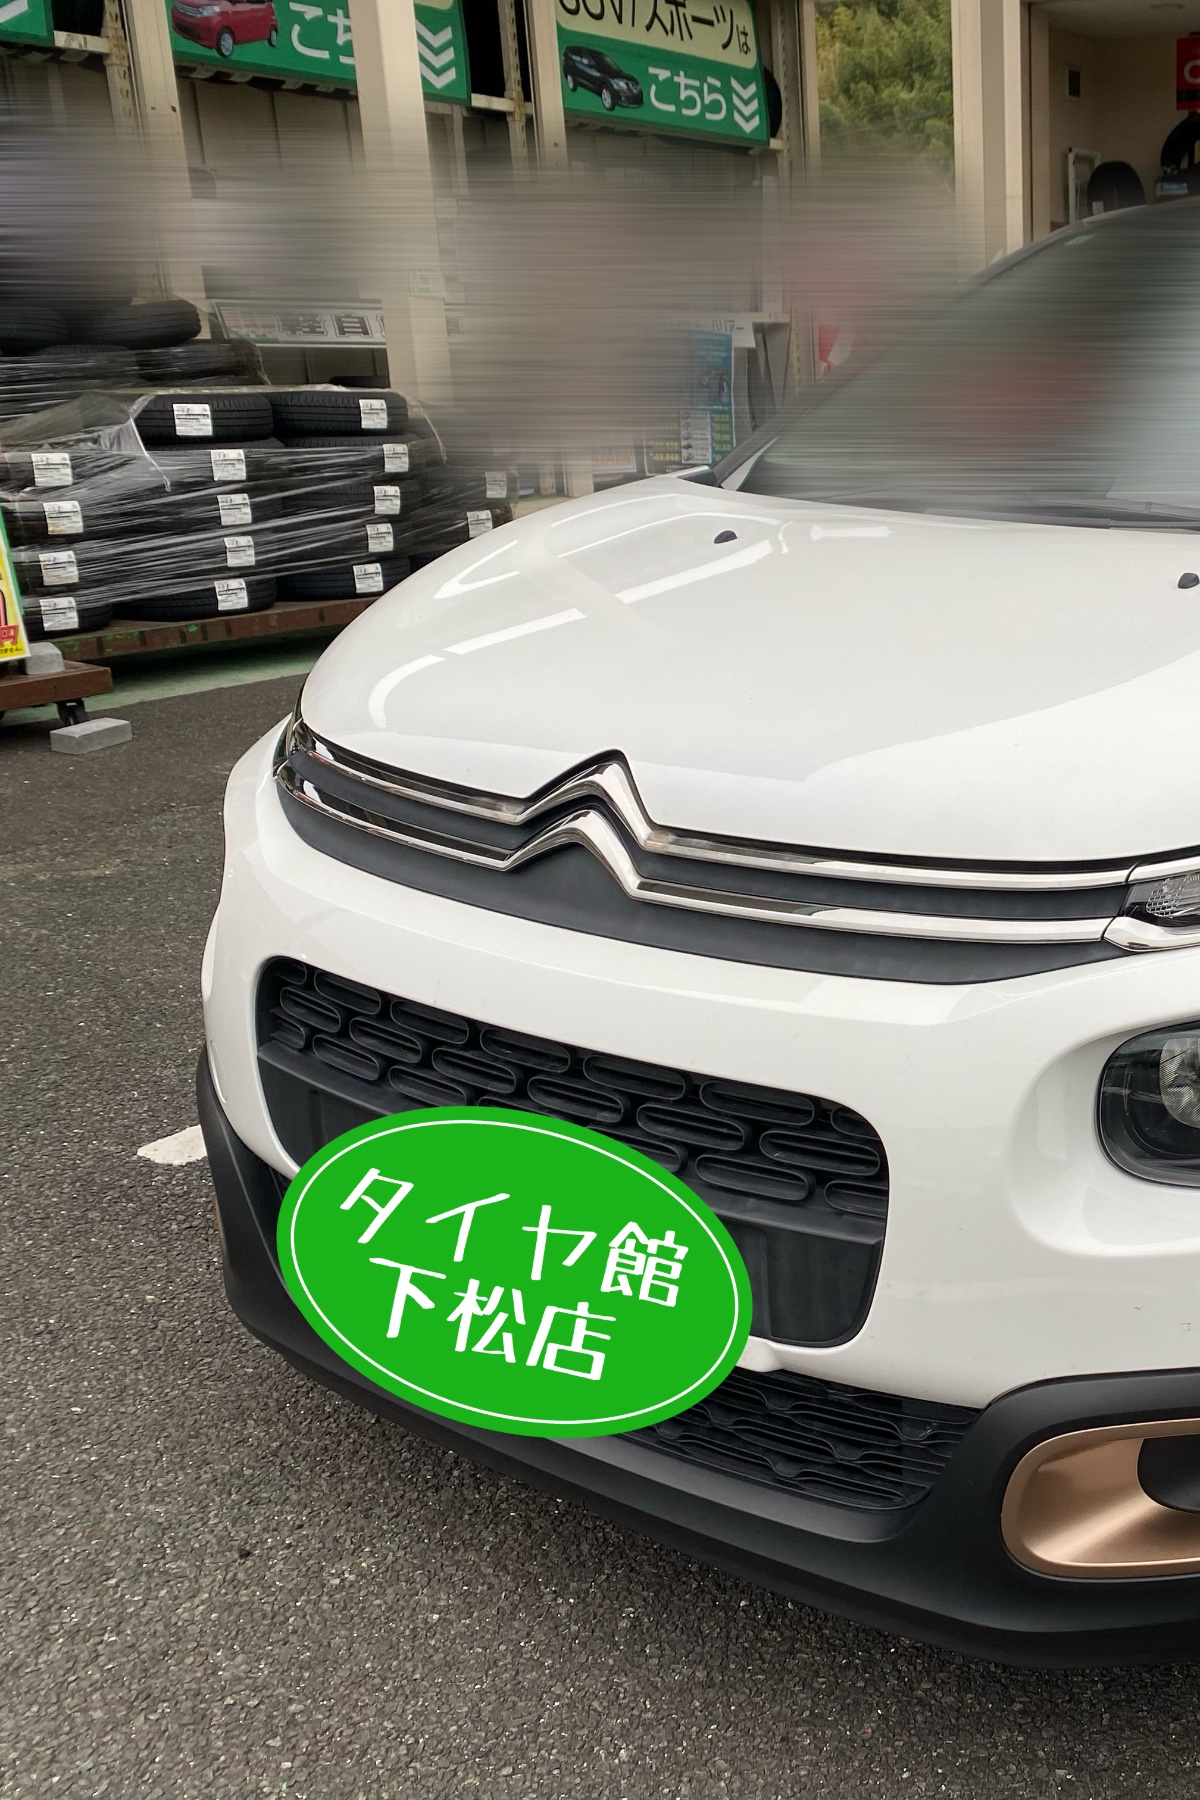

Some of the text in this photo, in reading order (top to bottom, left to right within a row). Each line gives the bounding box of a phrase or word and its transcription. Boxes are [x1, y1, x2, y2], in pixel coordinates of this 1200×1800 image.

[289, 1, 355, 65] こち
[648, 66, 727, 121] こちら
